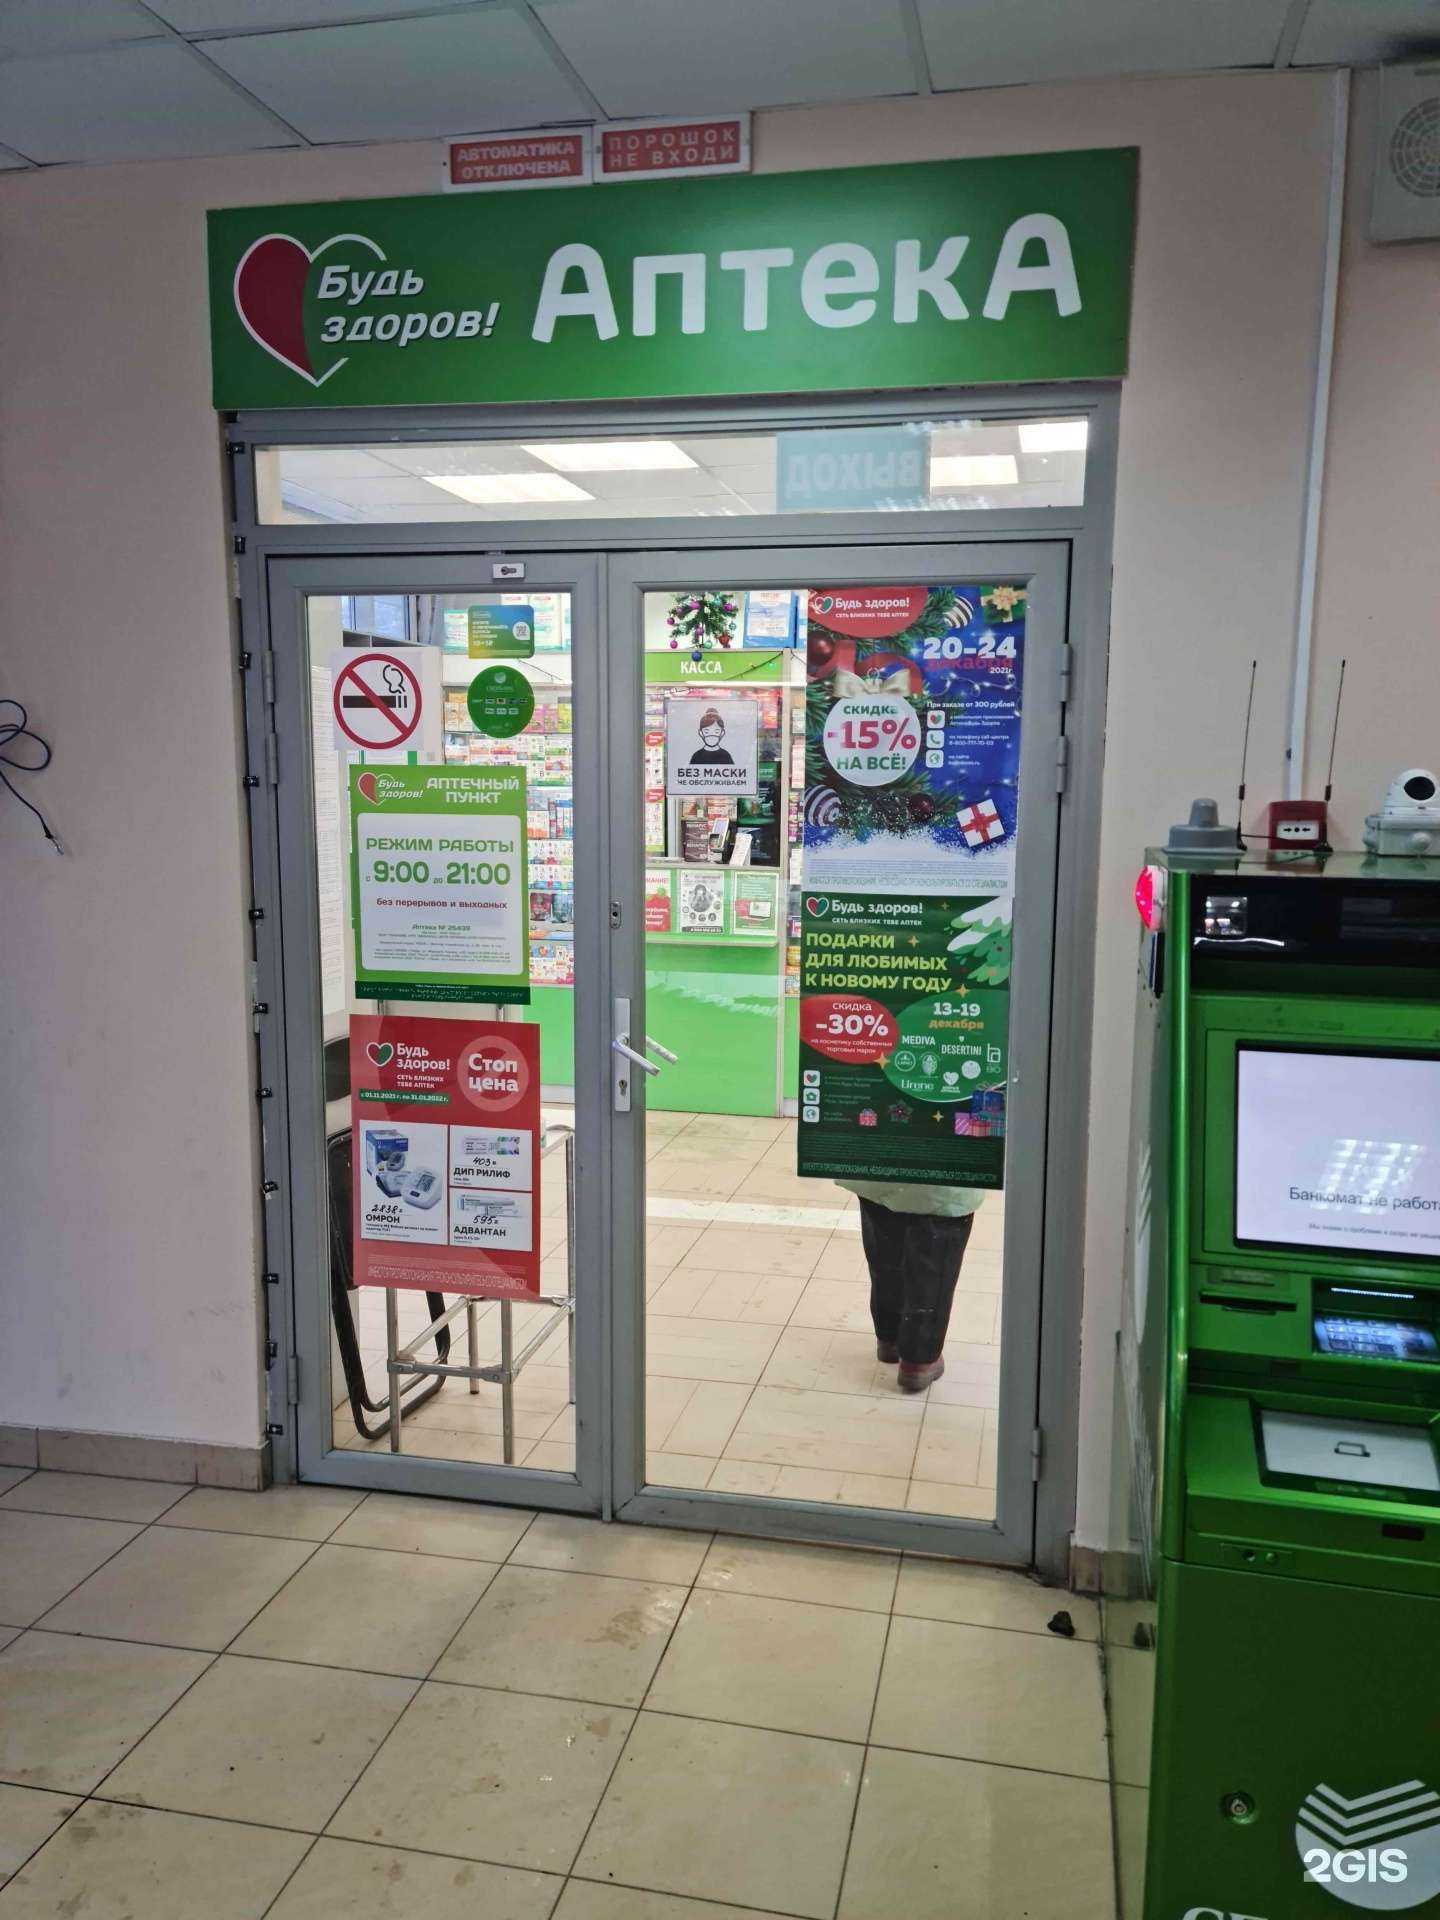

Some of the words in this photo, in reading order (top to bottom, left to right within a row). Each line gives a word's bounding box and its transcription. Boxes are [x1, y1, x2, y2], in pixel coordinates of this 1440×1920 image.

[608, 128, 735, 149] ПОРОШОК
[457, 141, 575, 161] АВТОМАТИКА
[610, 153, 637, 167] НЕ
[652, 145, 734, 164] ВХОДИ
[461, 160, 571, 179] ОТКЛЮЧЕНА
[317, 264, 424, 305] Будь
[320, 302, 500, 347] здоров!
[835, 597, 862, 610] Будь
[865, 597, 910, 610] здоров!
[923, 636, 1017, 660] 20-24
[681, 660, 723, 674] КАССА
[927, 701, 941, 709] При
[990, 700, 1015, 709] рублей
[827, 718, 917, 751] -15%
[836, 756, 865, 770] НА
[867, 753, 907, 770] ВСЁ!
[677, 768, 700, 777] БЕЗ
[704, 768, 747, 777] МАСКИ
[378, 779, 405, 789] Будь
[426, 775, 520, 790] АПТЕЧНЫЙ
[379, 790, 423, 799] здоров!
[445, 791, 501, 804] ПУНКТ
[366, 837, 432, 851] РЕЖИМ
[439, 839, 514, 853] РАБОТЫ
[373, 860, 430, 883] 9:00
[446, 862, 511, 885] 21:00
[376, 897, 393, 906] без
[395, 899, 447, 908] перерывов
[459, 901, 508, 909] выходных
[831, 900, 864, 915] Будь
[868, 901, 923, 916] здоров!
[806, 933, 895, 950] ПОДАРКИ
[805, 953, 844, 969] ДЛЯ
[848, 955, 948, 970] ЛЮБИМЫХ
[805, 973, 817, 986] К
[821, 975, 899, 989] НОВОМУ
[903, 977, 952, 993] ГОДУ
[933, 1002, 981, 1017] 13-19
[815, 1014, 889, 1038] -30%
[928, 1020, 984, 1031] декабря
[902, 1035, 936, 1046] MEDIVA
[396, 1042, 429, 1057] Будь
[941, 1044, 982, 1056] DESERTINI
[396, 1058, 450, 1072] здоров!
[468, 1053, 518, 1073] Стоп
[468, 1076, 519, 1093] цена
[453, 1167, 475, 1176] ДИП
[476, 1168, 511, 1178] РИЛИФ
[1289, 1187, 1363, 1205] Банкомат
[366, 1213, 400, 1223] ОМРОН
[453, 1225, 507, 1237] АДВАНТАН
